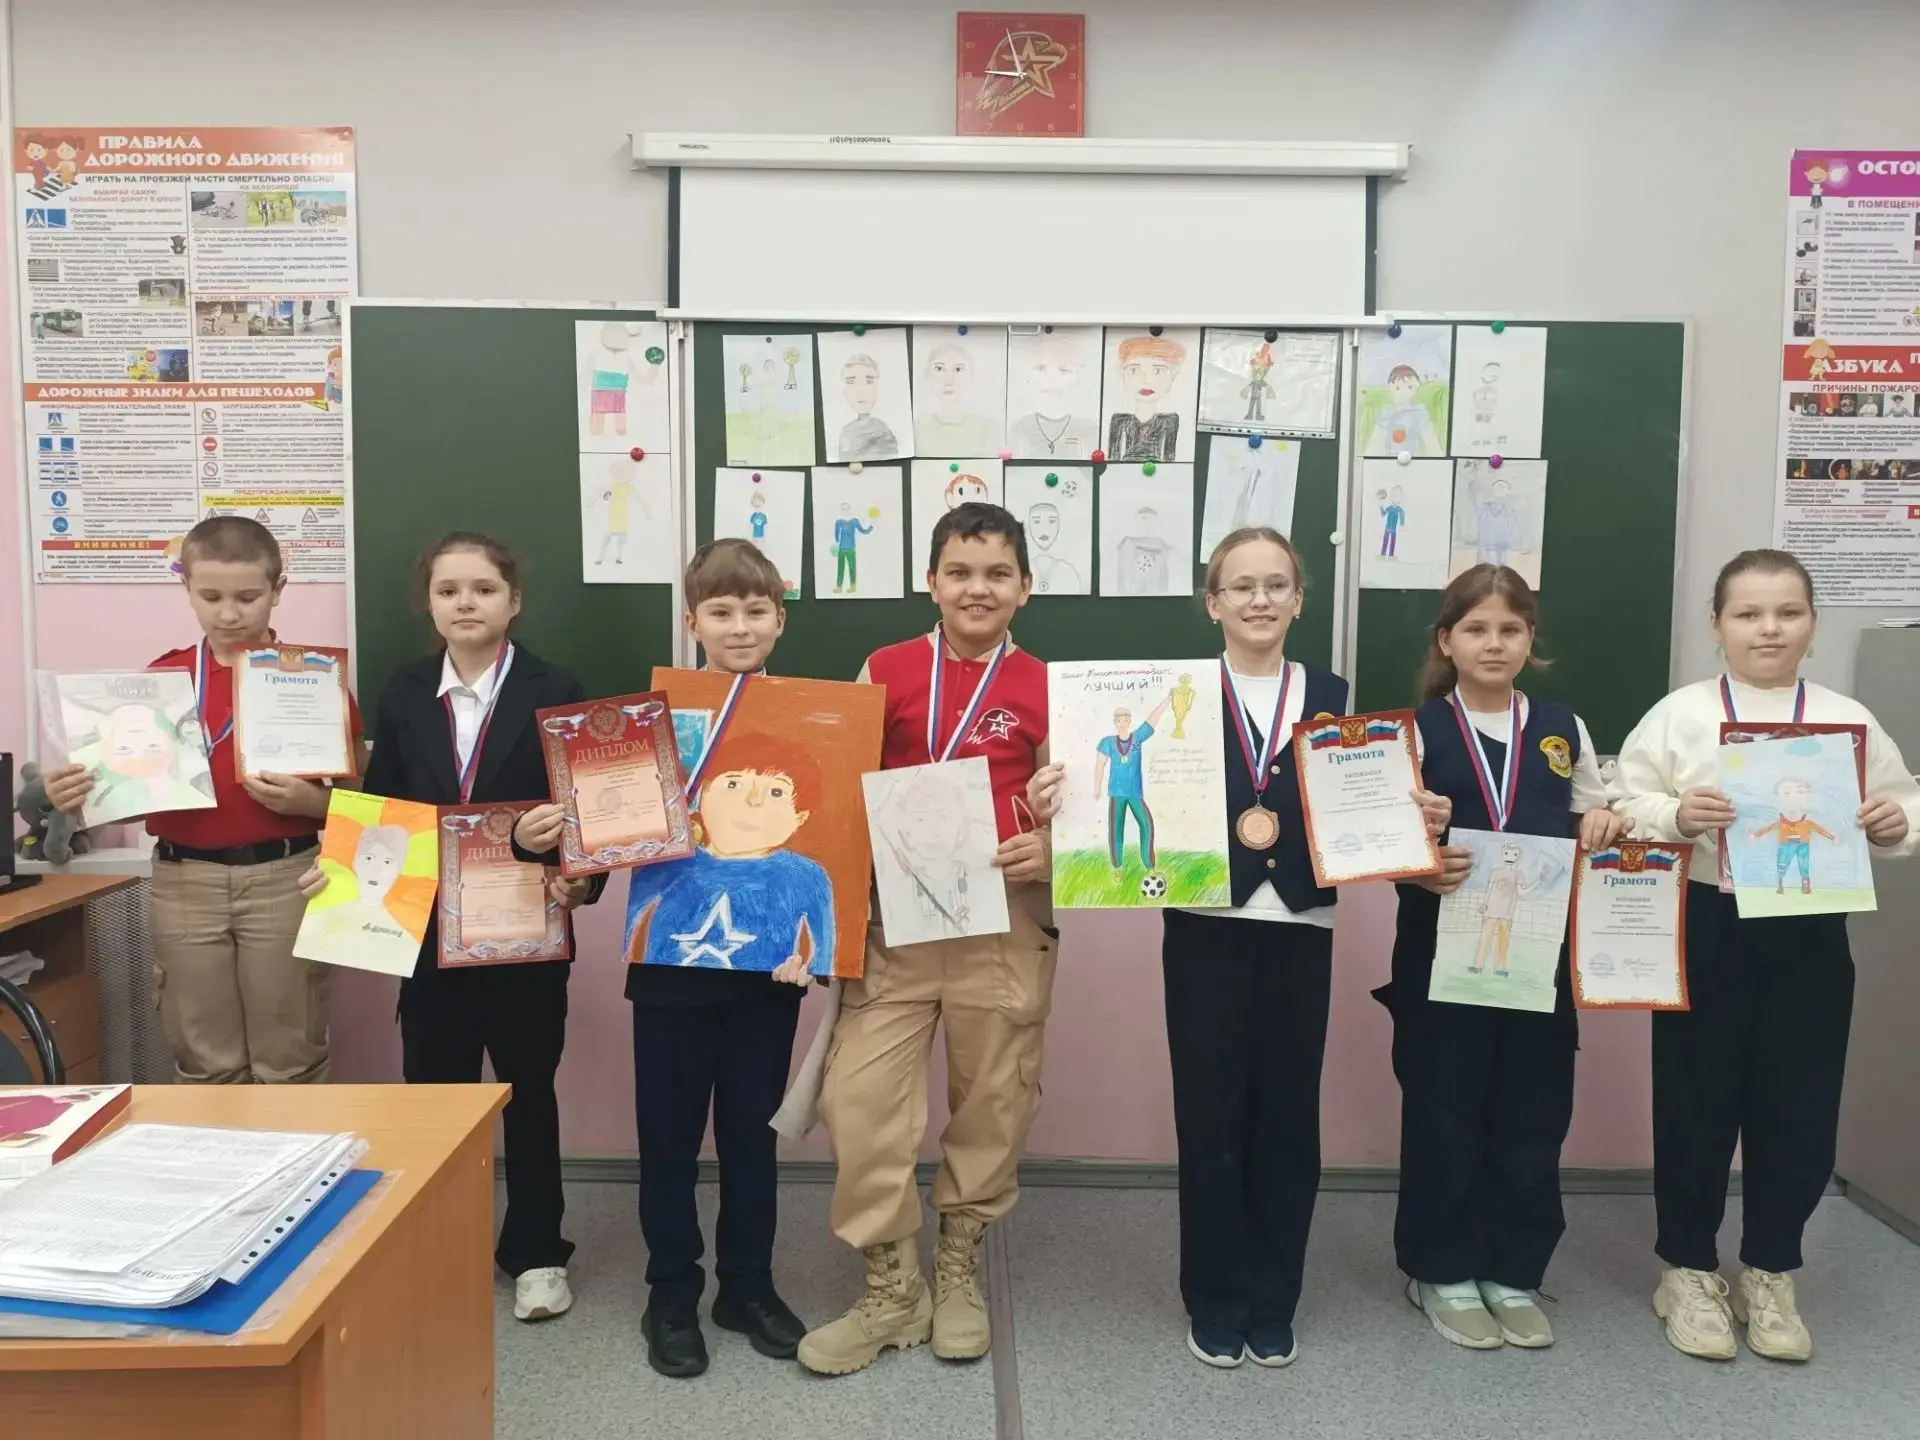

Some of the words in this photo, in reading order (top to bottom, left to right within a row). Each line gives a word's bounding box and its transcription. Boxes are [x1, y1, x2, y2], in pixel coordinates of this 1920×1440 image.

[99, 135, 203, 149] ПРАВИЛА
[84, 152, 222, 167] ДОРОЖНОГО
[1857, 160, 1920, 176] ОСТО
[85, 175, 121, 183] ИГРАТЬ
[124, 175, 138, 183] НА
[194, 175, 225, 183] ЧАСТИ
[228, 175, 291, 183] СМЕРТЕЛЬНО
[1847, 200, 1855, 208] В
[1823, 359, 1904, 373] АЗБУКА
[38, 387, 128, 398] ДОРОЖНЫЕ
[132, 387, 183, 397] ЗНАКИ
[186, 387, 218, 397] ДЛЯ
[220, 387, 315, 397] ПЕШЕХОДОВ
[1812, 384, 1868, 392] ПРИЧИНЫ
[1872, 384, 1920, 393] ПОЖАРО
[74, 541, 150, 549] ВНИМАНИЕ!
[264, 673, 319, 685] Грамота
[574, 738, 650, 766] ДИПЛОМ
[1327, 748, 1386, 765] Грамота
[465, 846, 512, 861] ДИПЛ
[1603, 874, 1657, 888] Грамота
